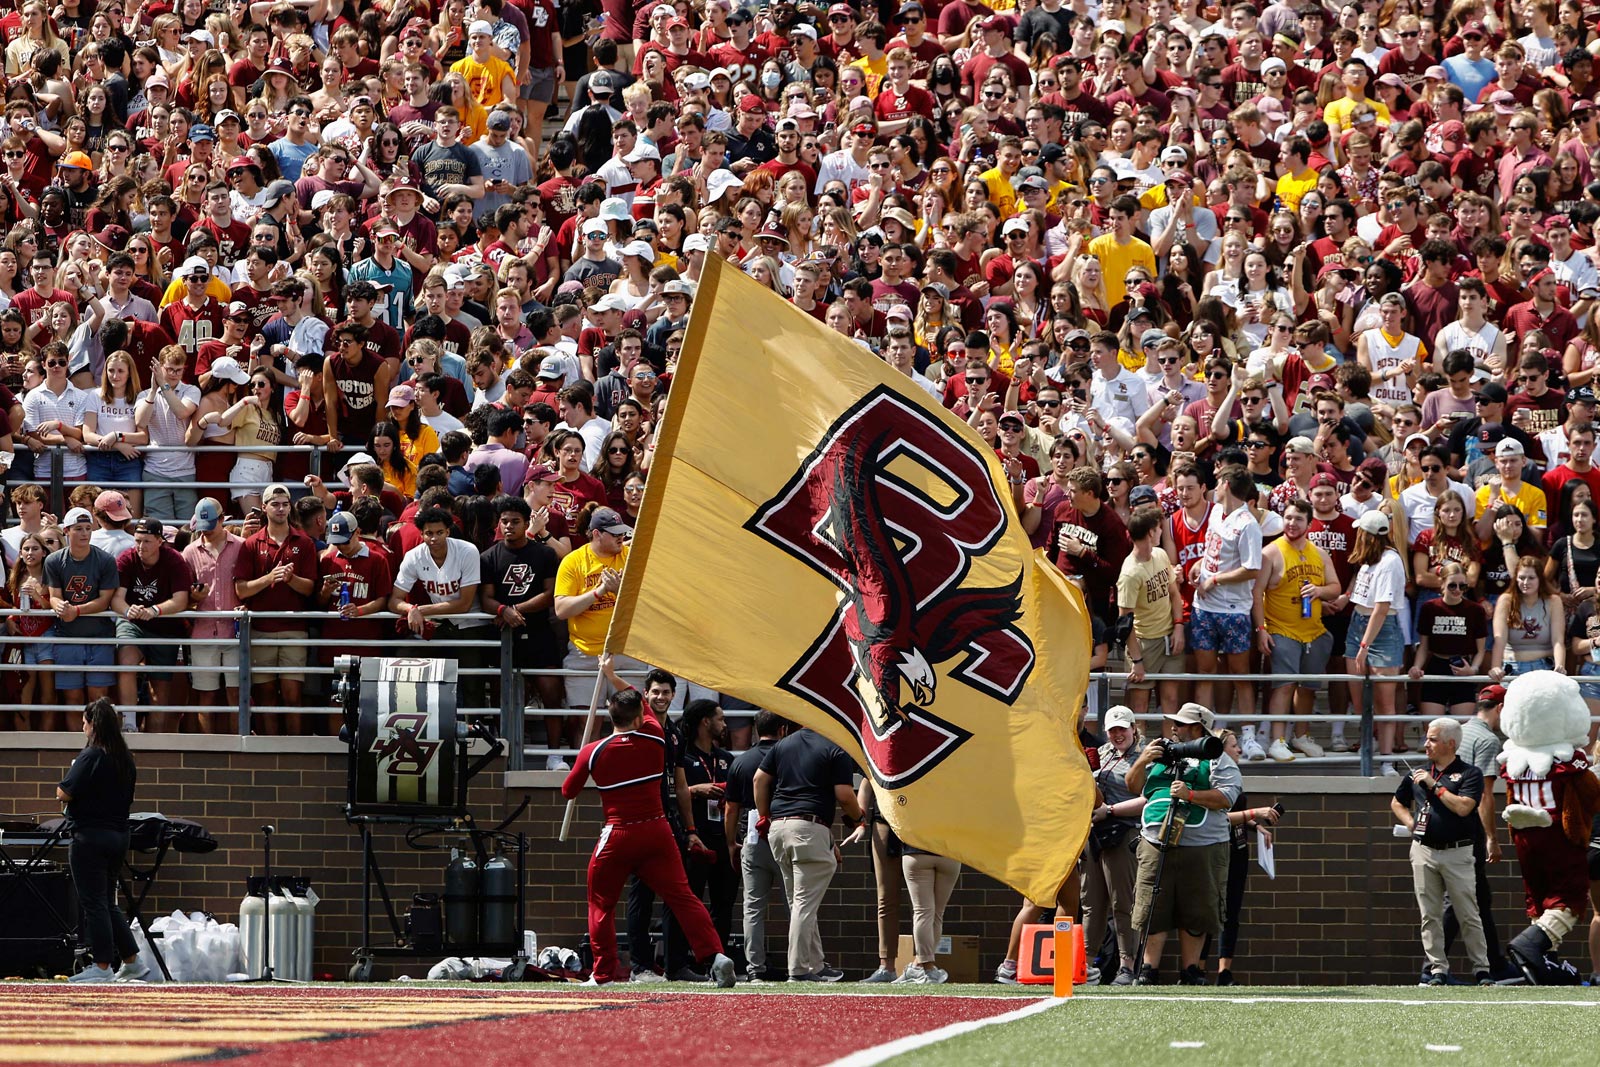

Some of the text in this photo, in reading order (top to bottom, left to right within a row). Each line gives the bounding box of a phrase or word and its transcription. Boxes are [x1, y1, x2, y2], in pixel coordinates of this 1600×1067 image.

[178, 320, 213, 353] 40
[1377, 357, 1404, 370] BOST
[100, 405, 135, 416] EAGLES
[1307, 531, 1345, 542] BOSTON
[1433, 616, 1466, 626] BOSTON
[1431, 625, 1467, 636] COLLEGE
